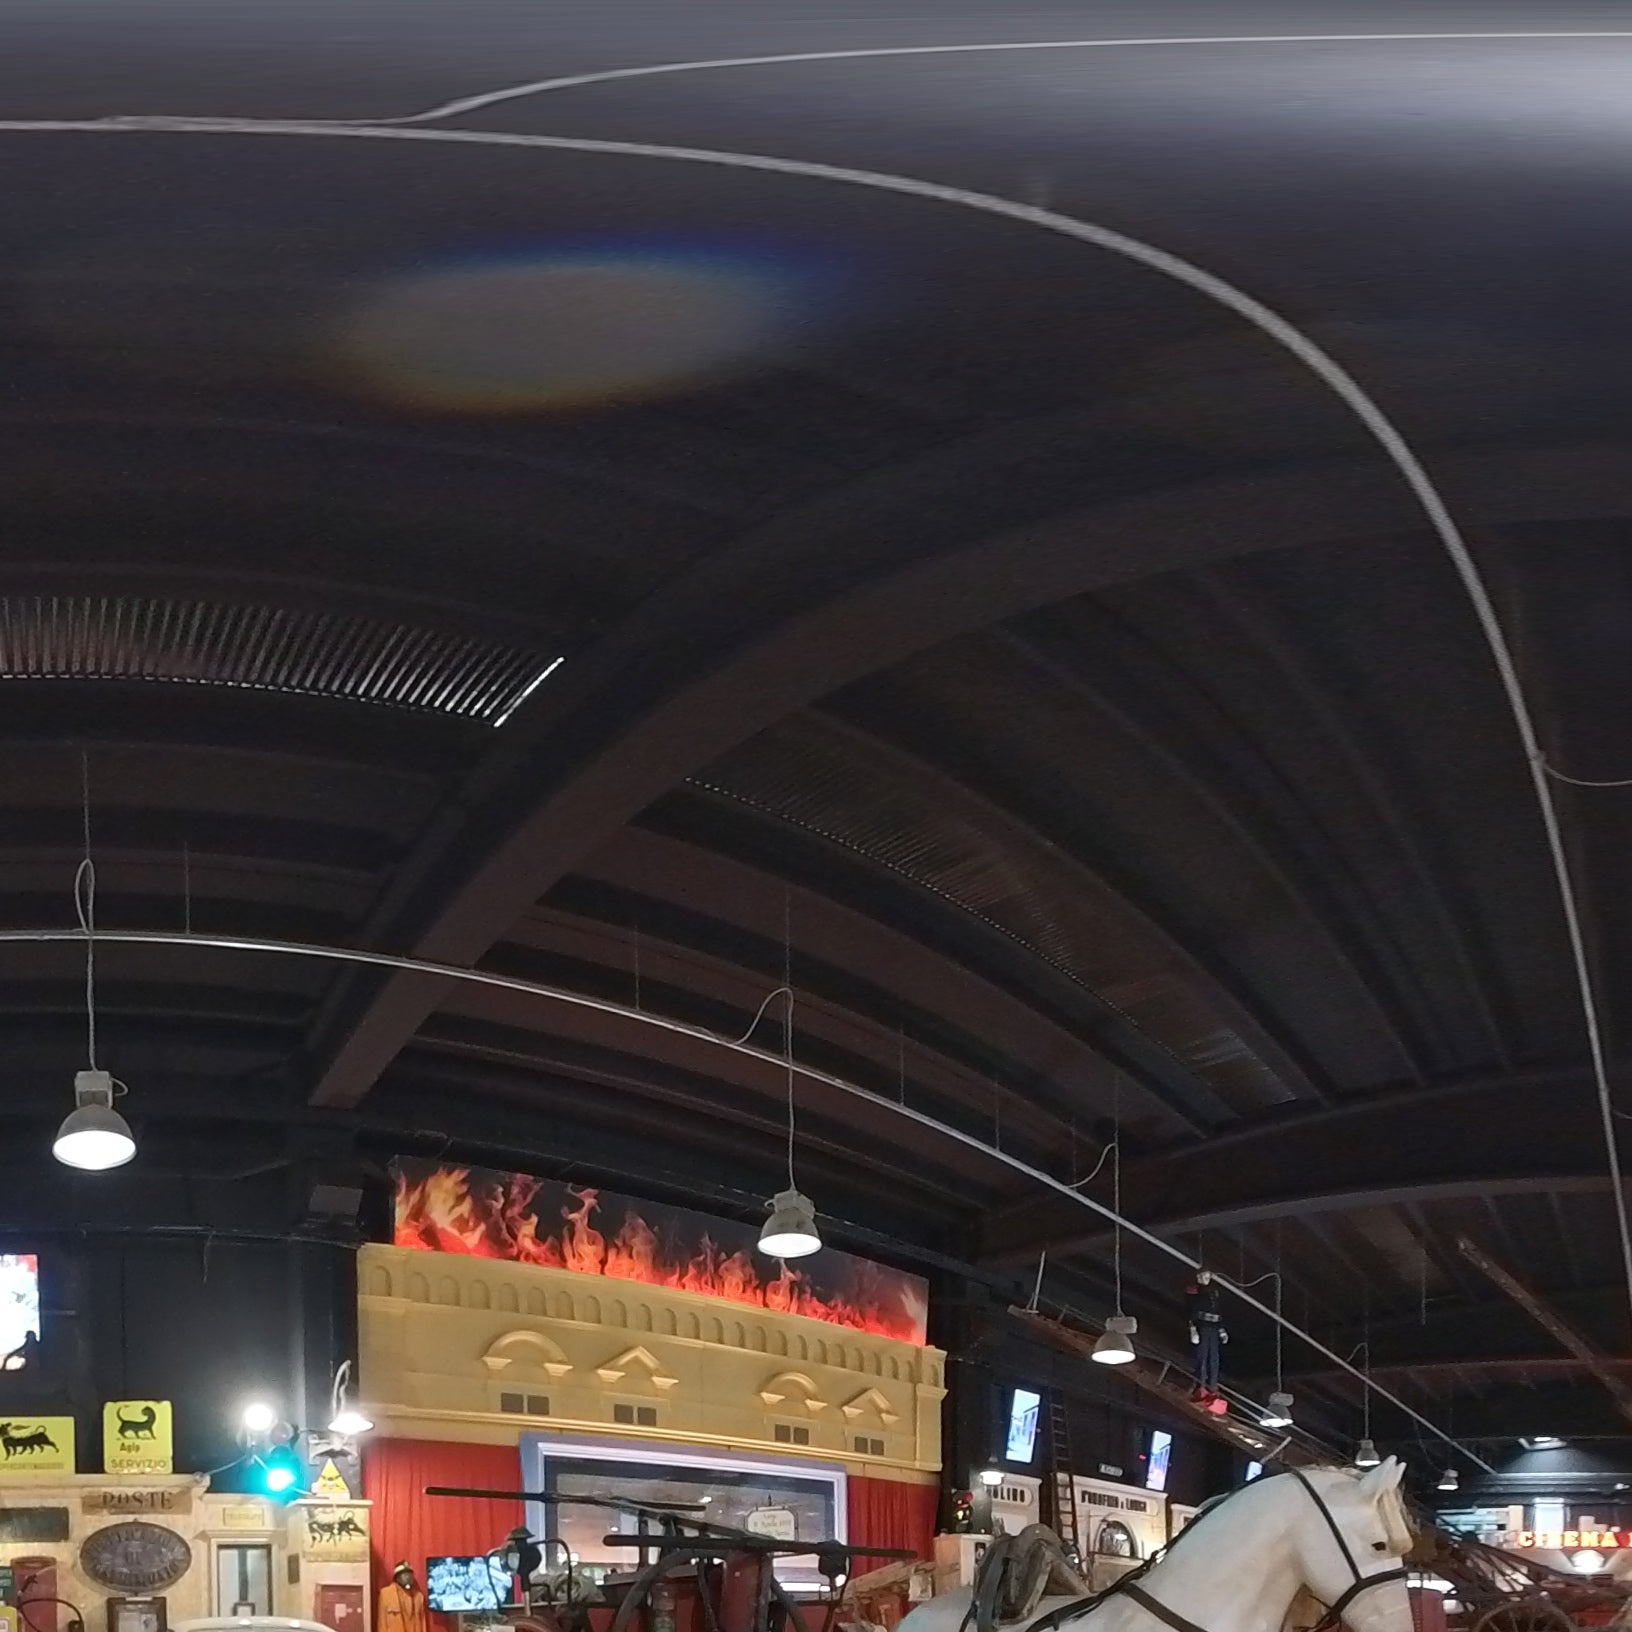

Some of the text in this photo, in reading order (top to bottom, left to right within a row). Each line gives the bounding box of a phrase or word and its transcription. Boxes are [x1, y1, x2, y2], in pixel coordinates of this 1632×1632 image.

[111, 1459, 167, 1469] SERVIZIO
[102, 1491, 175, 1510] POSTE
[1518, 1531, 1619, 1549] CINEMA
